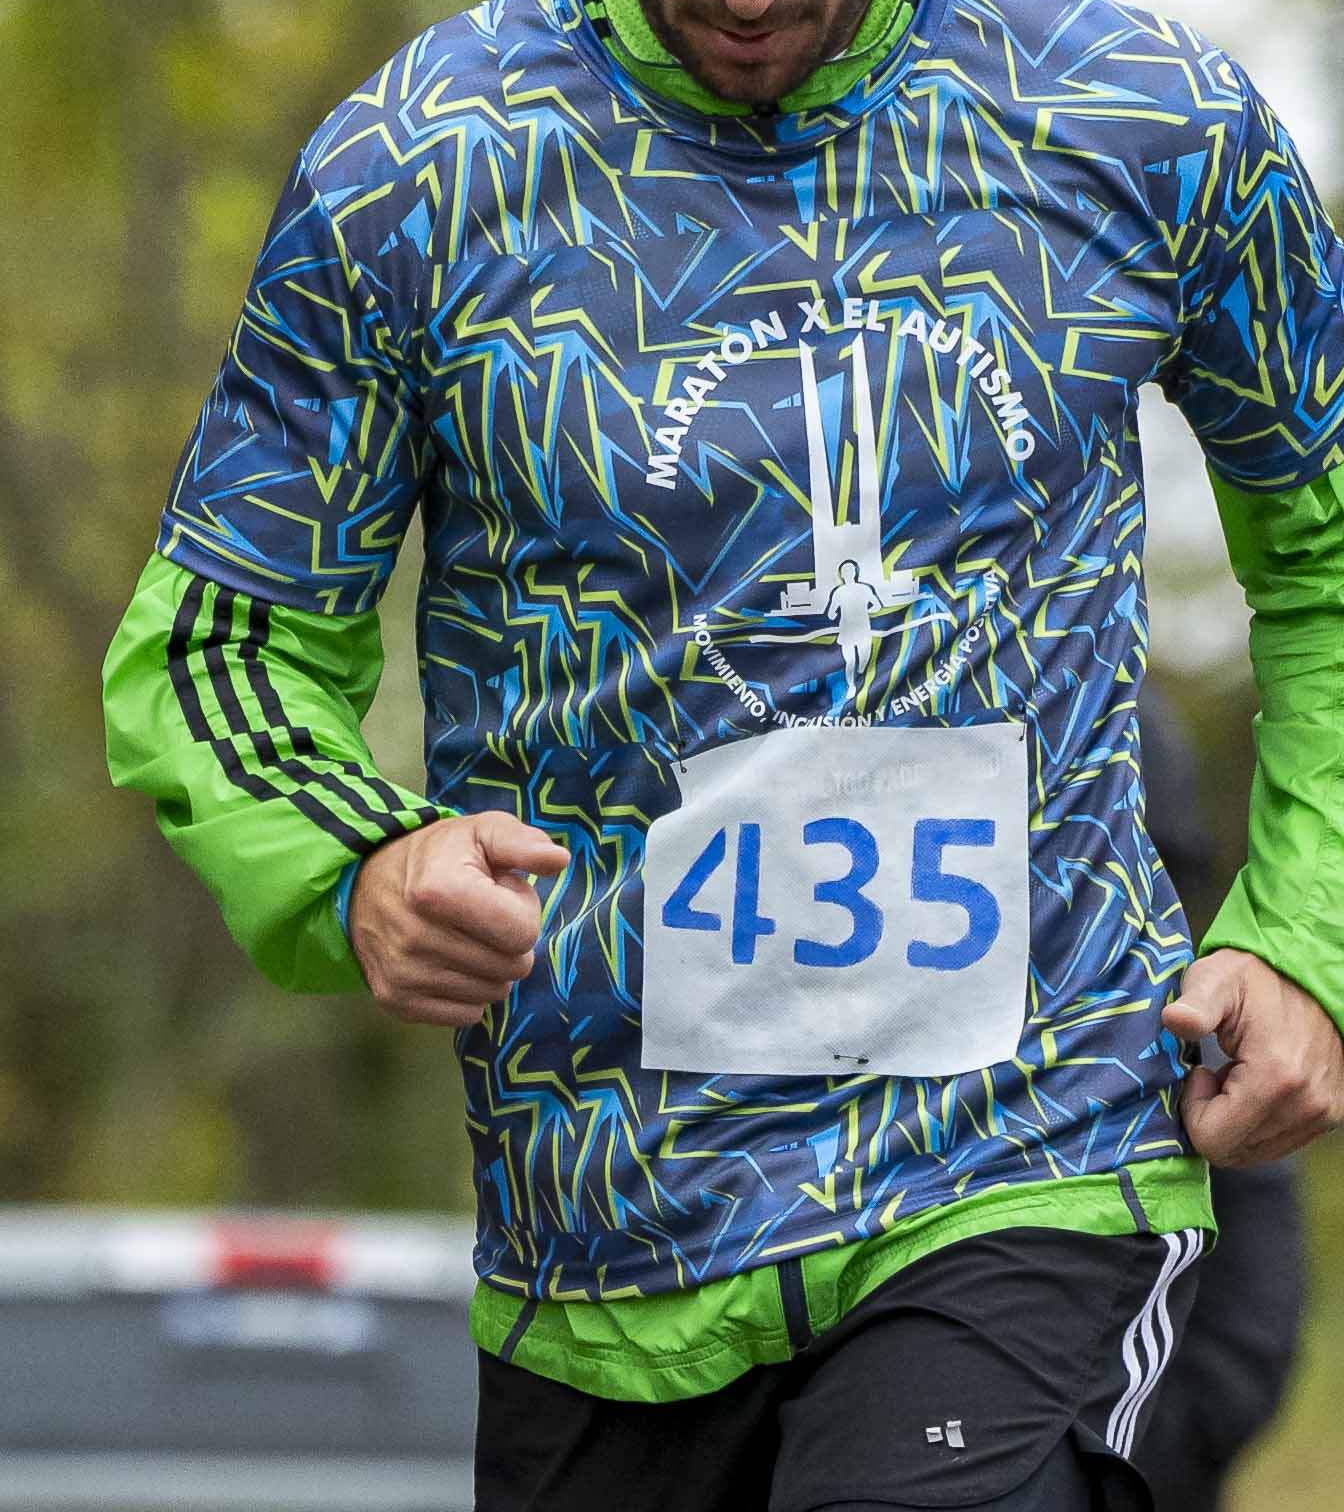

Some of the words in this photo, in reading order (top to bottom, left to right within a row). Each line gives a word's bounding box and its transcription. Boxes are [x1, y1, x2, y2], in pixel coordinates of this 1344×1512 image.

[645, 309, 789, 490] MARATÓN
[798, 297, 830, 333] X
[843, 296, 886, 333] EL
[899, 311, 1036, 462] AUTISMO
[874, 704, 887, 722] Y
[891, 654, 968, 717] ENERGÍA
[661, 816, 1002, 971] 435
